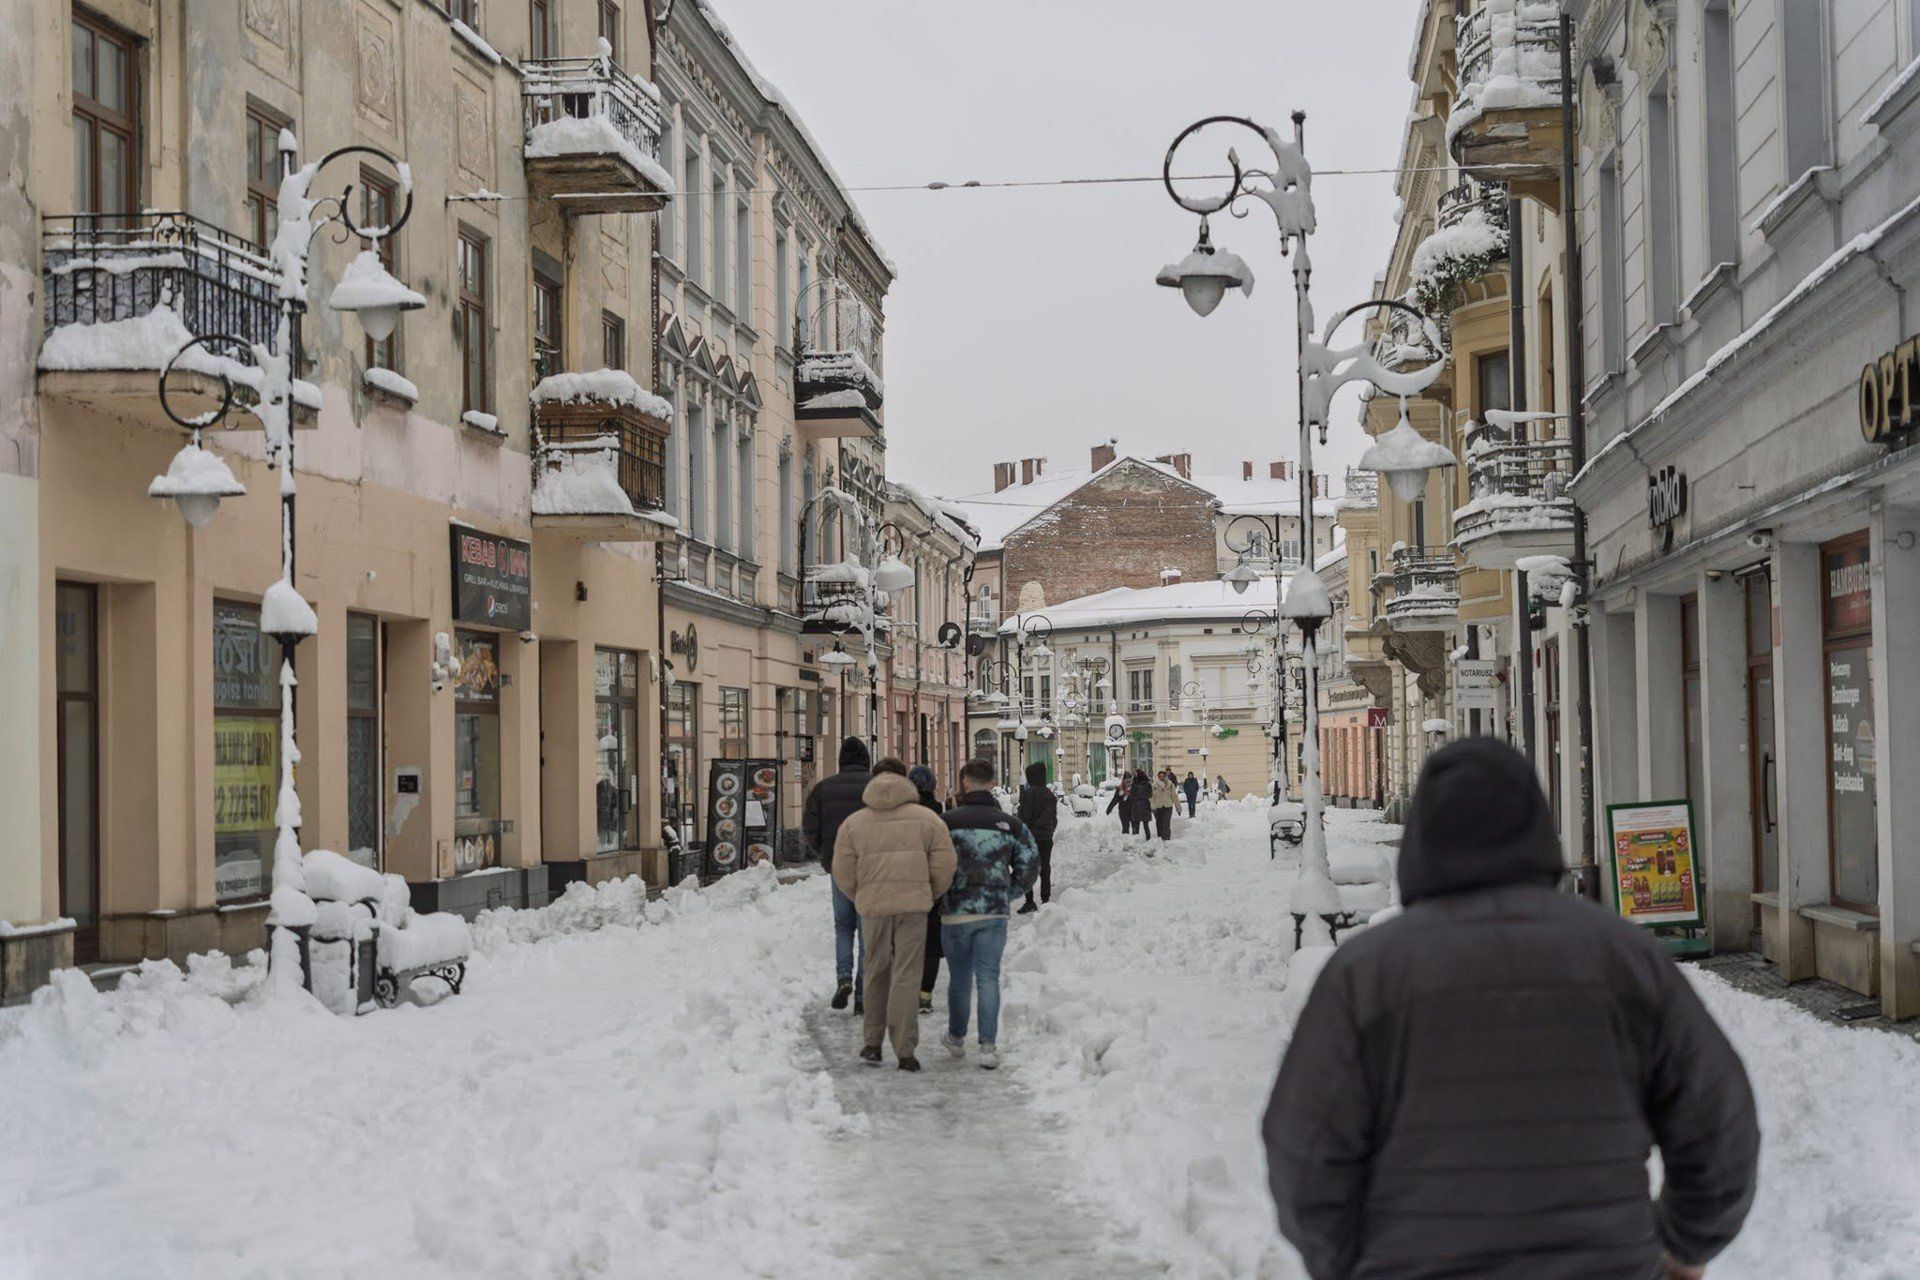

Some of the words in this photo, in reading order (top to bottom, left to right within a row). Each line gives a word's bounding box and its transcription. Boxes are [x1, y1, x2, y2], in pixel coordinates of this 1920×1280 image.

[1859, 333, 1920, 444] OPT
[461, 535, 496, 568] KEBAB
[510, 548, 528, 578] INN
[1830, 561, 1870, 598] HAMBURG
[1460, 669, 1493, 677] NOTARIUSZ
